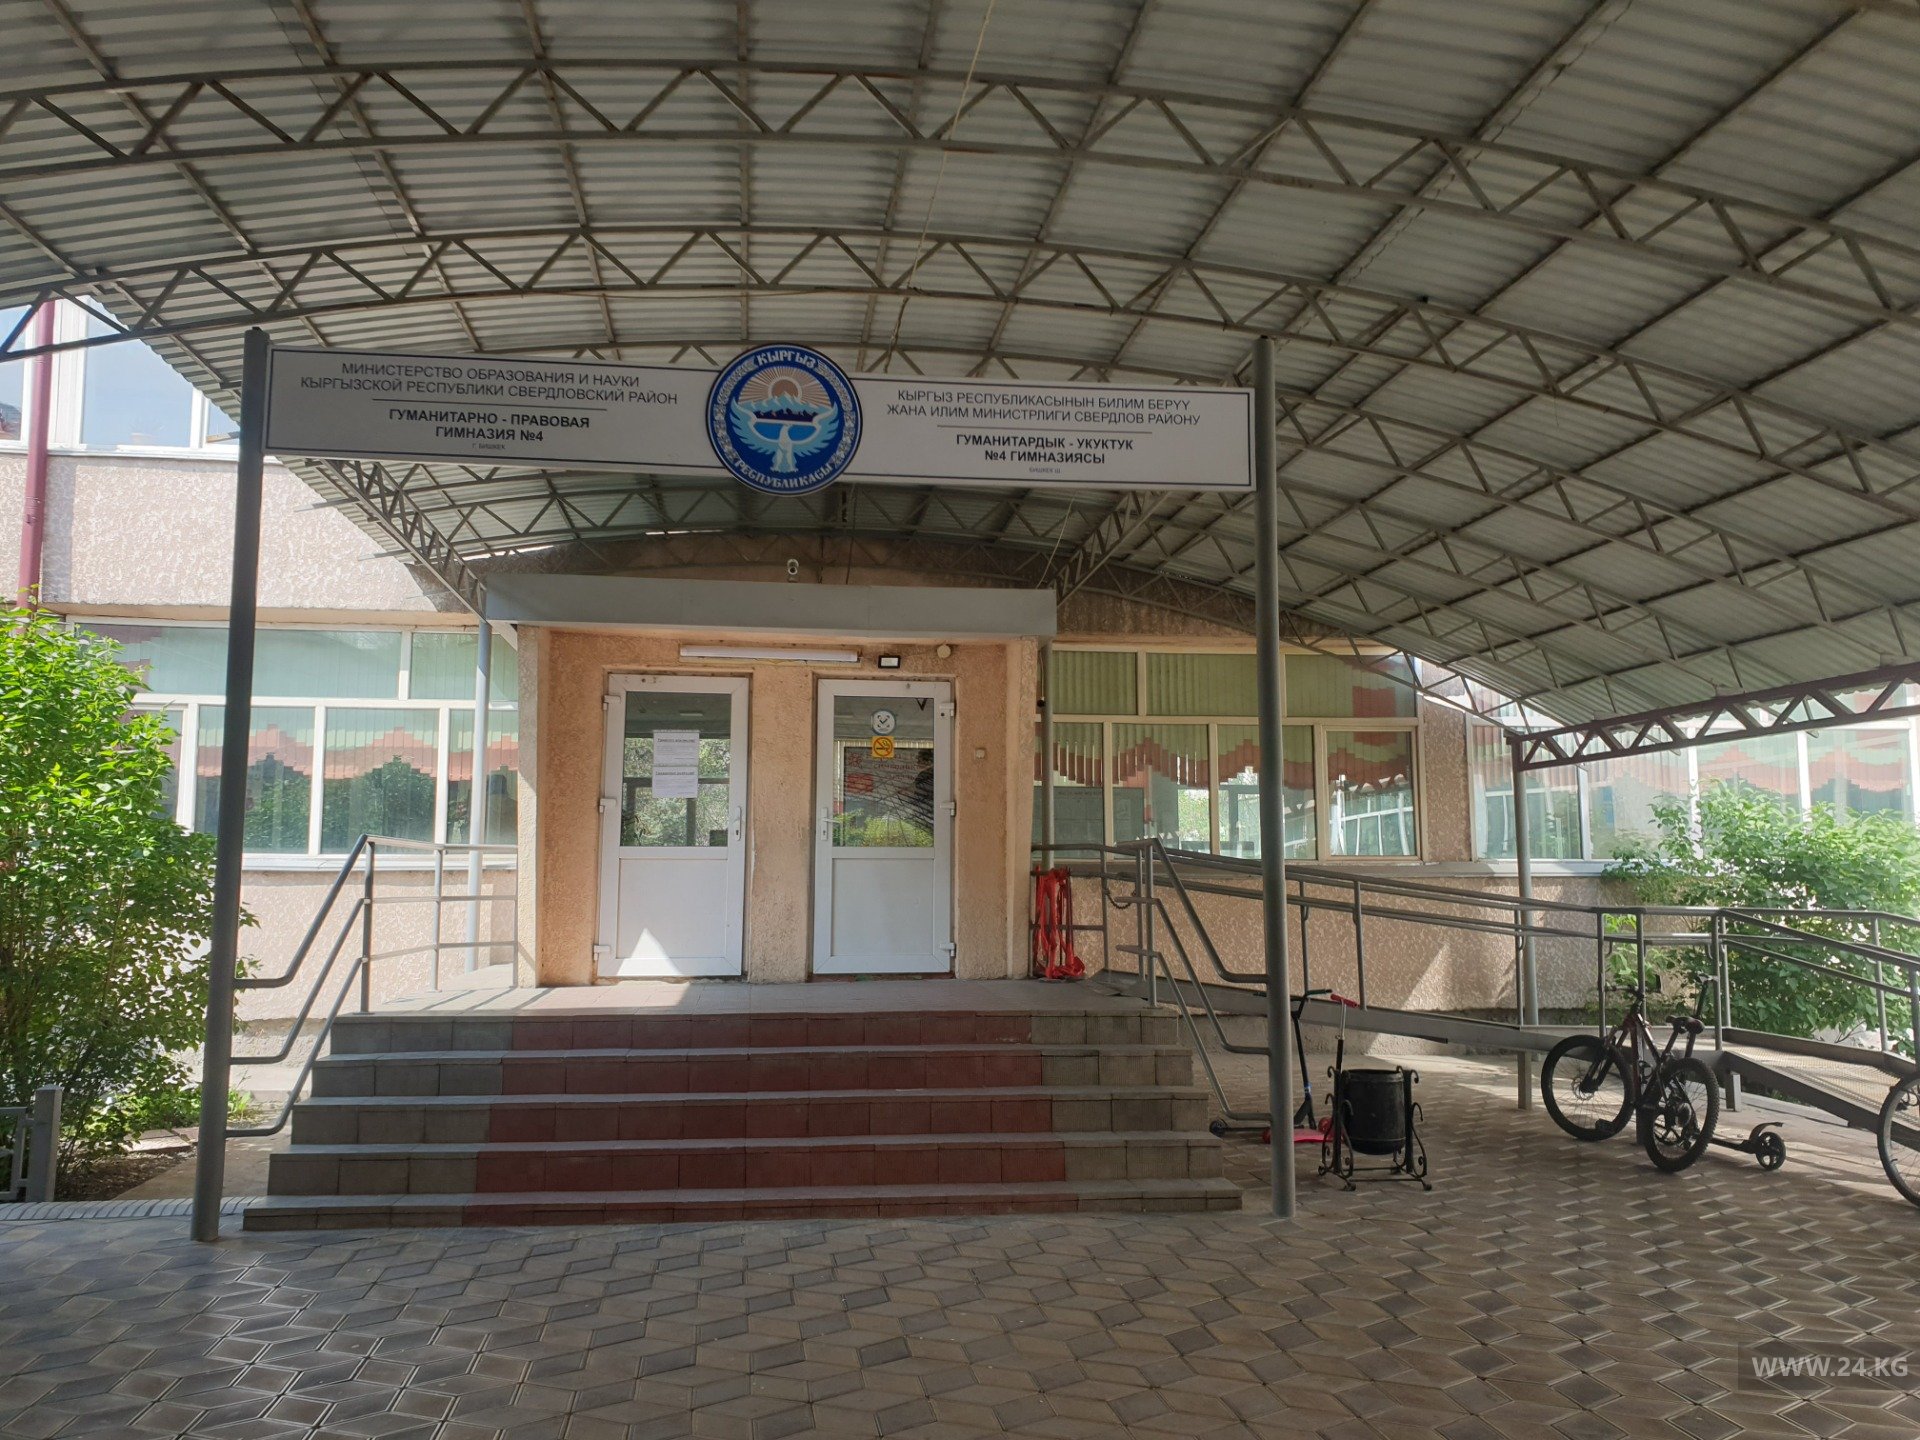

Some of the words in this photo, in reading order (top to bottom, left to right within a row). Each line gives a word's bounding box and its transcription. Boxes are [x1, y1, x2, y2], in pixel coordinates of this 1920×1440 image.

[756, 350, 816, 368] КЫРГЫЗ
[342, 363, 462, 379] МИНИСТЕРСТВО
[467, 368, 574, 384] ОБРАЗОВАНИЯ
[580, 374, 589, 384] И
[593, 375, 639, 387] НАУКИ
[301, 377, 402, 391] КЫРГЫЗСКОЙ
[407, 382, 503, 396] РЕСПУБЛИКИ
[508, 385, 624, 402] СВЕРДЛОВСКИЙ
[629, 390, 678, 405] РАЙОН
[898, 390, 953, 402] КЫРГЫЗ
[957, 392, 1094, 408] РЕСПУБЛИКАСЫНЫН
[1098, 398, 1144, 409] БИЛИМ
[389, 408, 498, 424] ГУМАНИТАРНО
[511, 414, 590, 428] ПРАВОВАЯ
[887, 404, 927, 416] ЖАНА
[930, 406, 968, 418] ИЛИМ
[972, 408, 1071, 421] МИНИСТРЛИГИ
[1074, 411, 1144, 424] СВЕРДЛОВ
[1148, 413, 1200, 425] РАЙОНУ
[436, 426, 515, 440] ГИМНАЗИЯ
[520, 429, 544, 441] №4
[956, 434, 1065, 449] ГУМАНИТАРДЫК
[1077, 438, 1133, 450] УКУКТУК
[985, 450, 1006, 461] №4
[1010, 451, 1105, 464] ГИМНАЗИЯСЫ
[734, 459, 834, 489] РЕСПУБЛИКАСЫ
